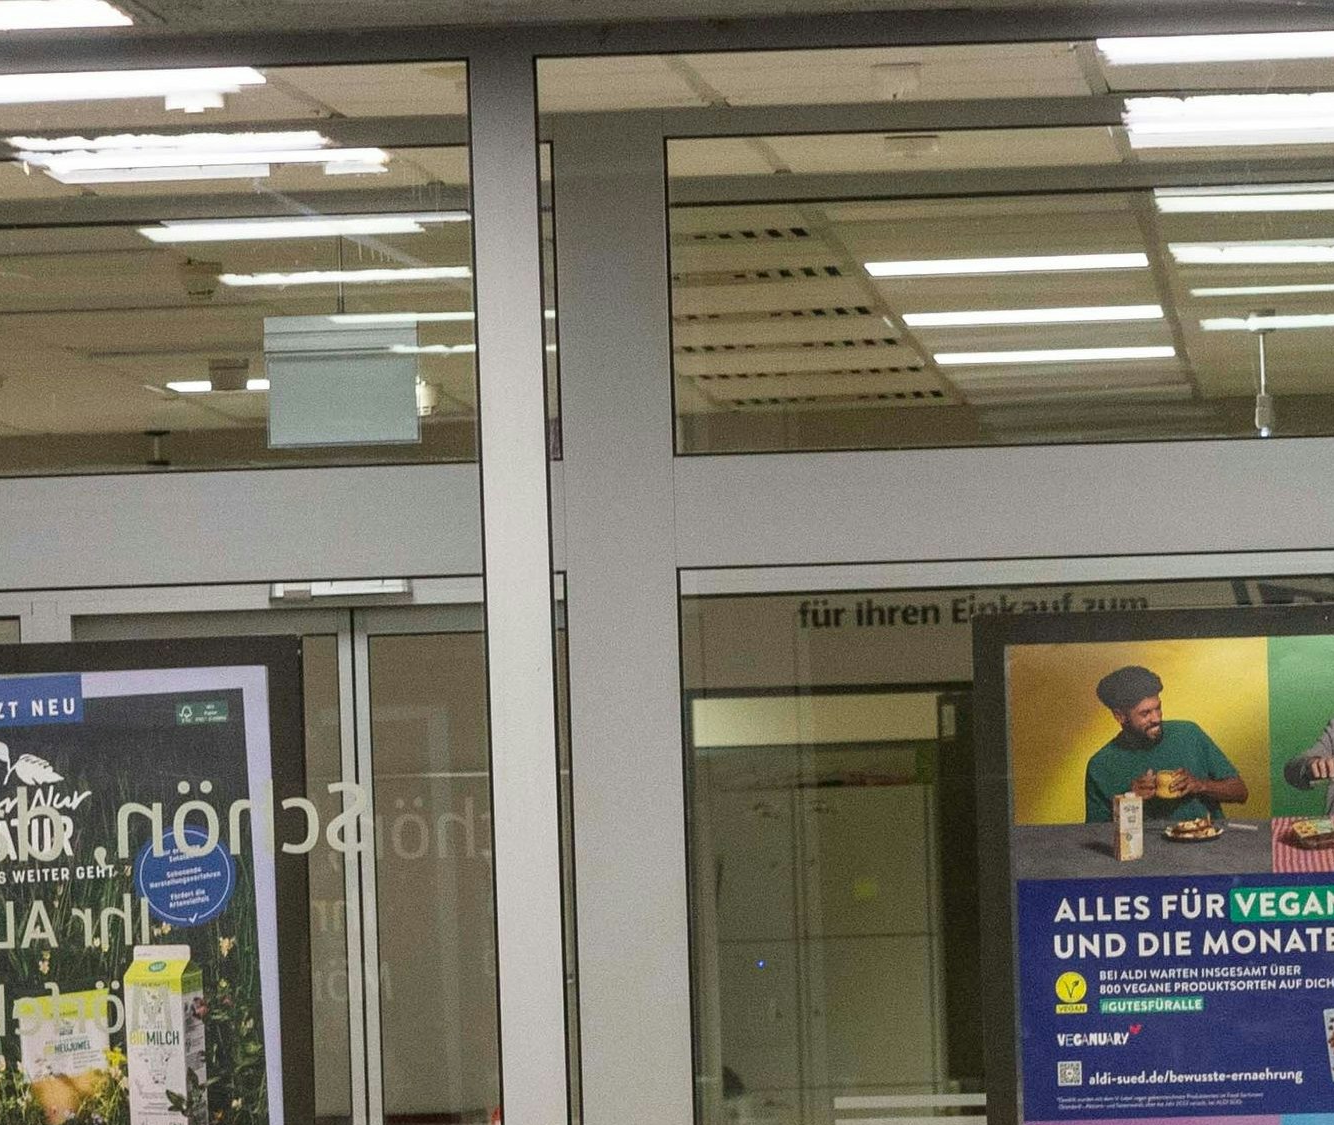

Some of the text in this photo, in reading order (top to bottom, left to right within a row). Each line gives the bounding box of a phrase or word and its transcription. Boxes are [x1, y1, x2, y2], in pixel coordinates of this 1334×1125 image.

[797, 599, 845, 628] für
[30, 697, 76, 717] NEU
[12, 866, 69, 885] WEITER
[1053, 895, 1151, 924] ALLES
[1161, 887, 1226, 920] FÜR
[1052, 932, 1127, 960] UND
[1137, 930, 1192, 957] DIE
[1099, 964, 1302, 981] BEI ALDI WARTEN INSGESAMT ÜBER
[1099, 983, 1122, 995] 800
[1123, 982, 1172, 994] VEGANE
[1173, 979, 1277, 993] PRODUKTSORTEN
[1278, 978, 1302, 990] AUF
[1056, 1004, 1086, 1013] VEGAN
[1100, 998, 1203, 1013] #GUTESFÜRALLE
[1056, 1031, 1130, 1047] VEGANUARY
[1088, 1067, 1304, 1086] aldi-sued.de/bewusste-ernaehrung
